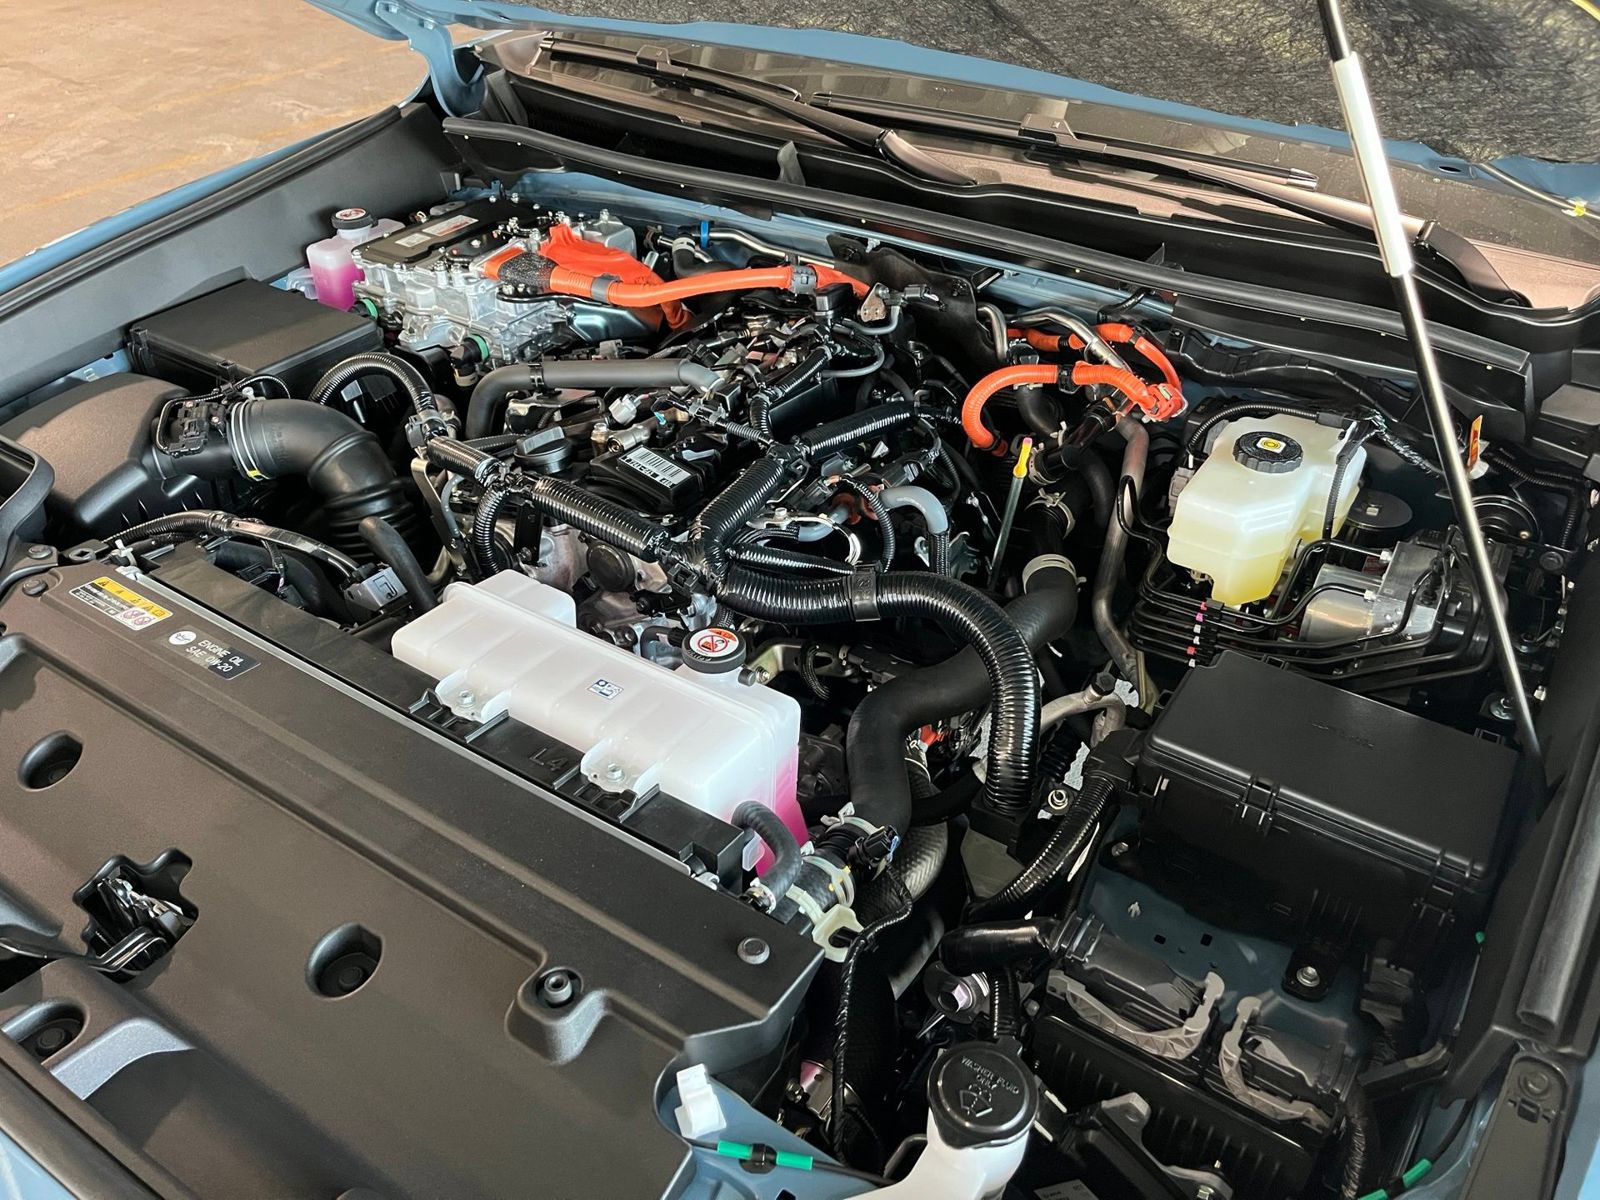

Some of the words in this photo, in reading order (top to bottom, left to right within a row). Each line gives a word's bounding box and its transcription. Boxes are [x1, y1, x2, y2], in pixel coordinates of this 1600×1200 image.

[185, 646, 208, 658] SAE
[205, 656, 233, 673] 0W-20
[198, 639, 231, 658] ENGINE
[228, 656, 245, 667] OIL
[961, 1057, 994, 1080] WASHER
[996, 1076, 1019, 1094] FLUID
